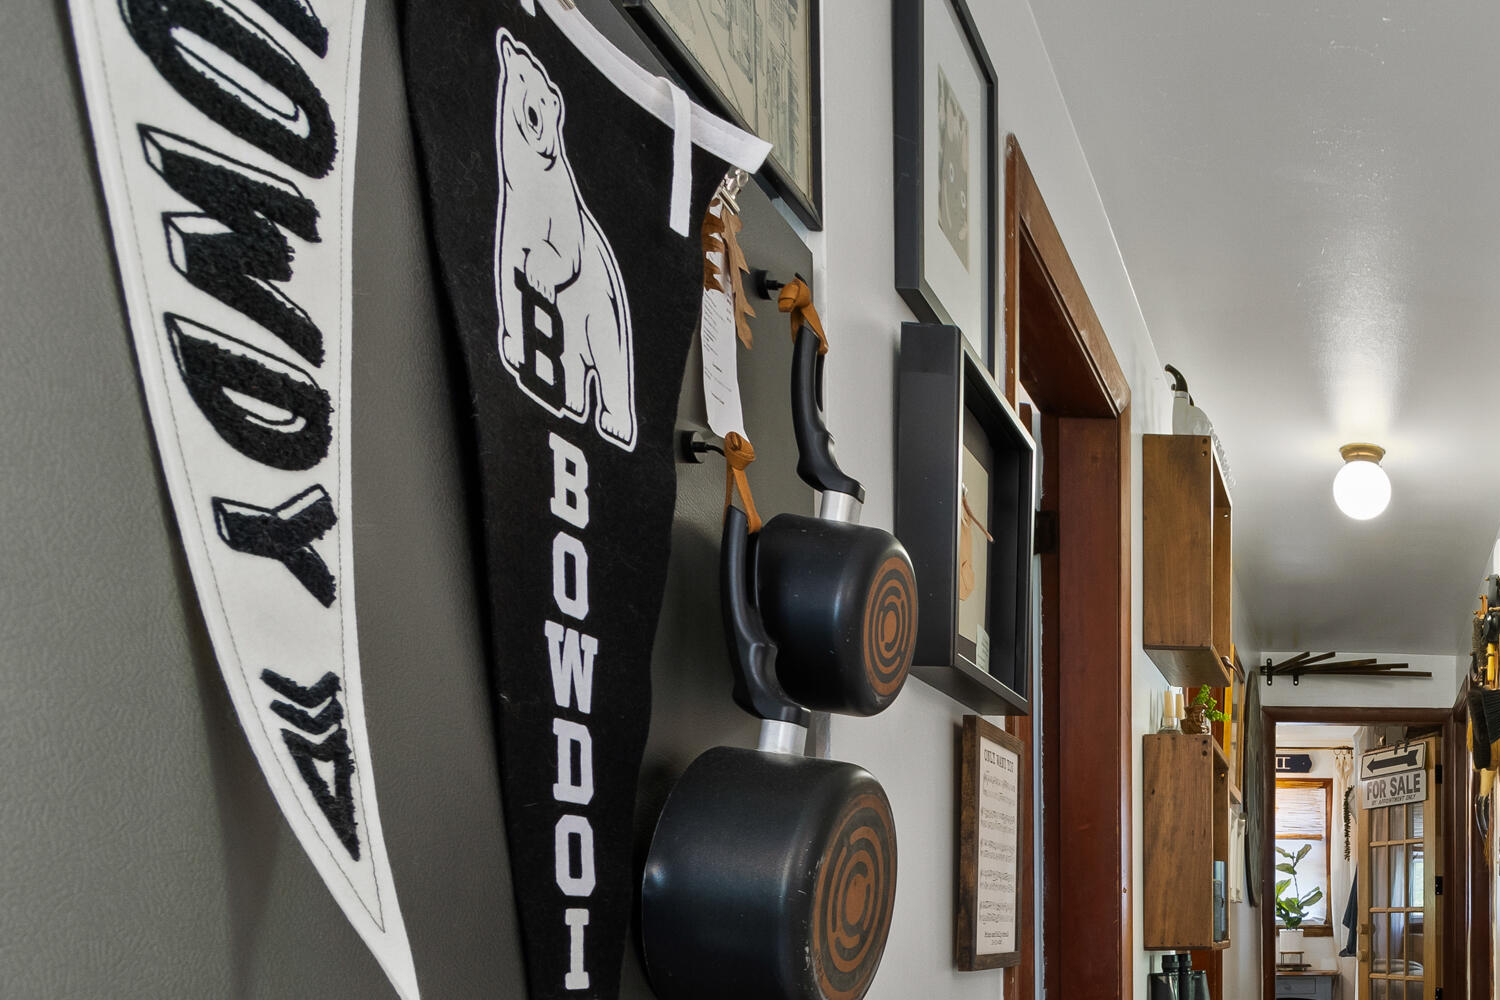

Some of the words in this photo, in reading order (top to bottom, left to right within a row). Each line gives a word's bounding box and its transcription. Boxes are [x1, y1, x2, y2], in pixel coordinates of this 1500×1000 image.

[117, 0, 338, 607] OWDY
[1366, 779, 1387, 801] FOR
[1390, 773, 1421, 797] SALE
